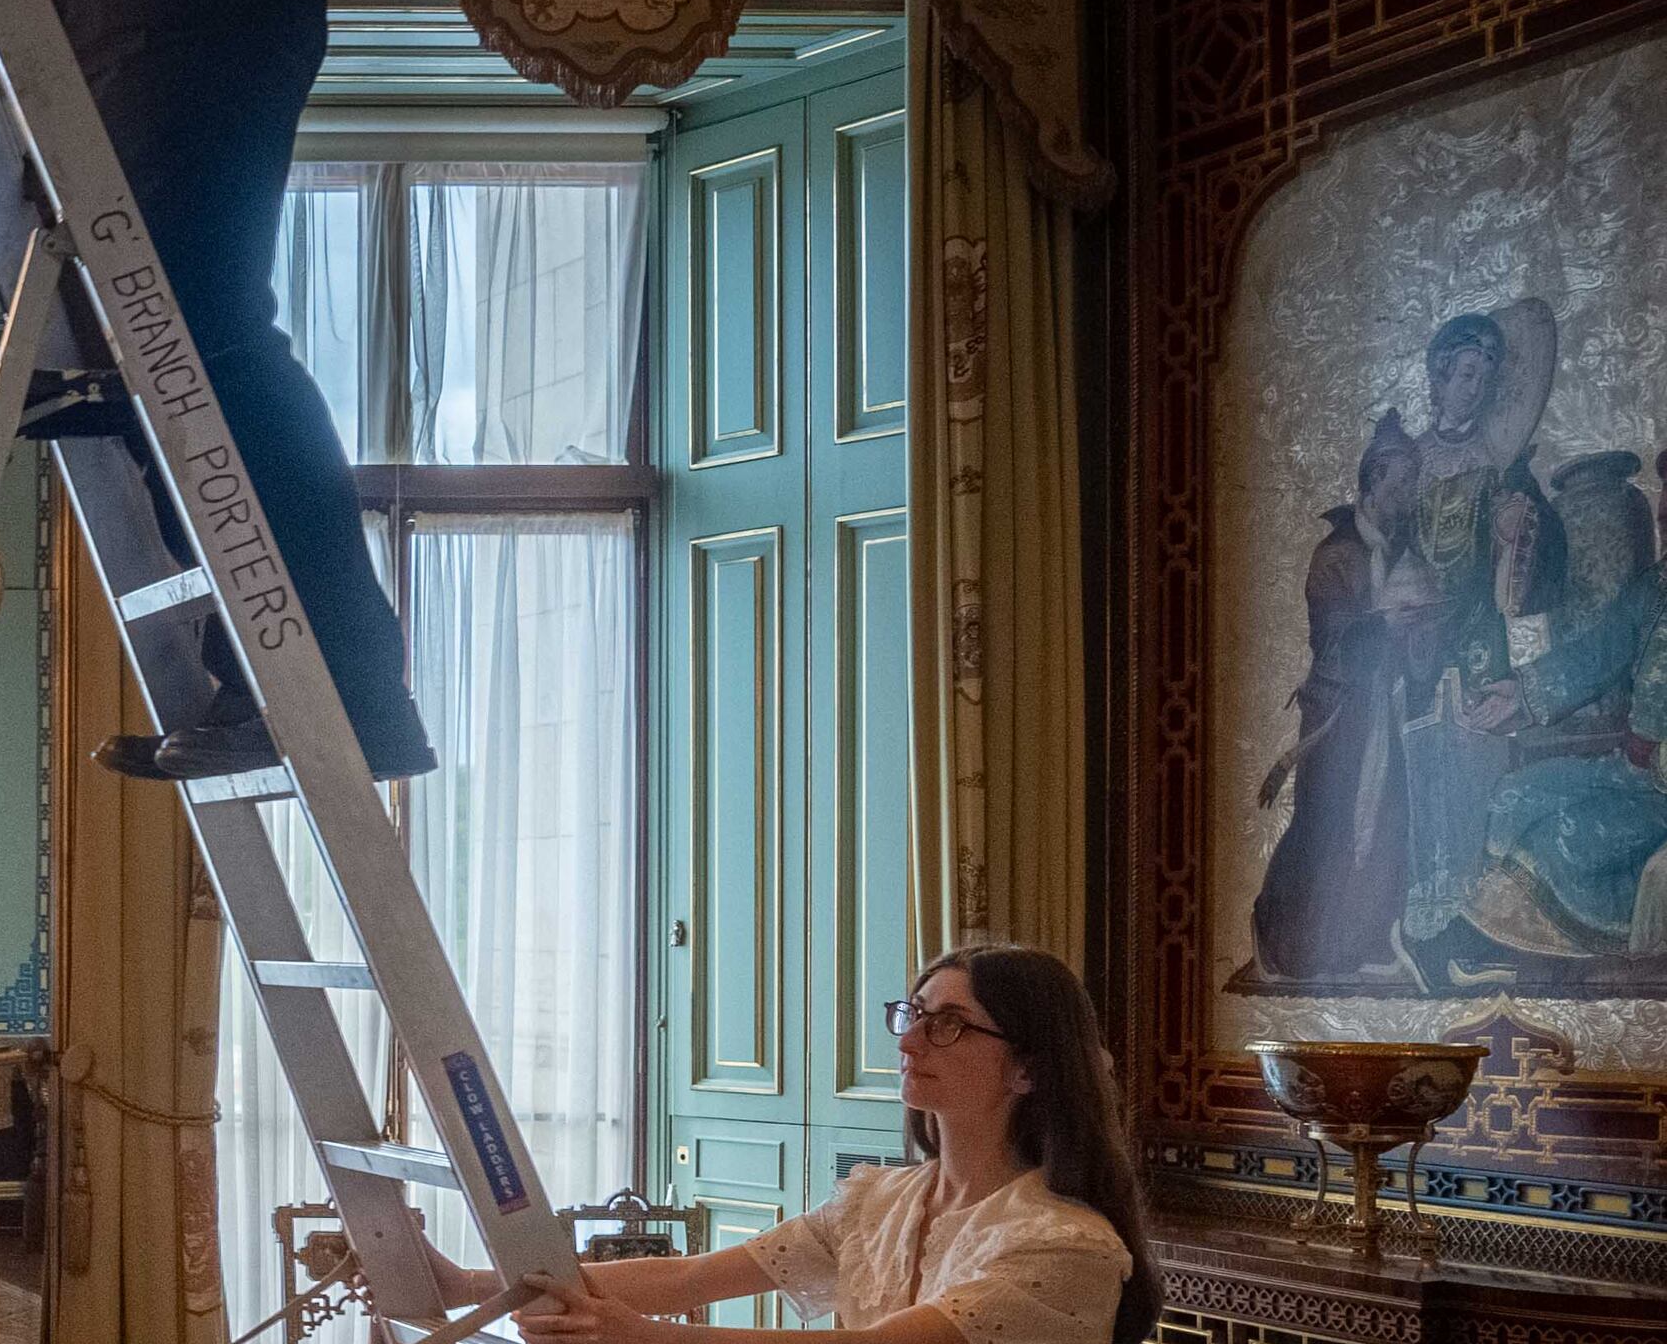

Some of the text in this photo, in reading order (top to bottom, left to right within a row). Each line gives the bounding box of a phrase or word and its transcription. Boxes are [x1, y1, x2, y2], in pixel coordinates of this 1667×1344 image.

[111, 265, 210, 419] BRANCH
[186, 445, 304, 651] PORTERS
[459, 1070, 515, 1199] CLOW LADDERS
